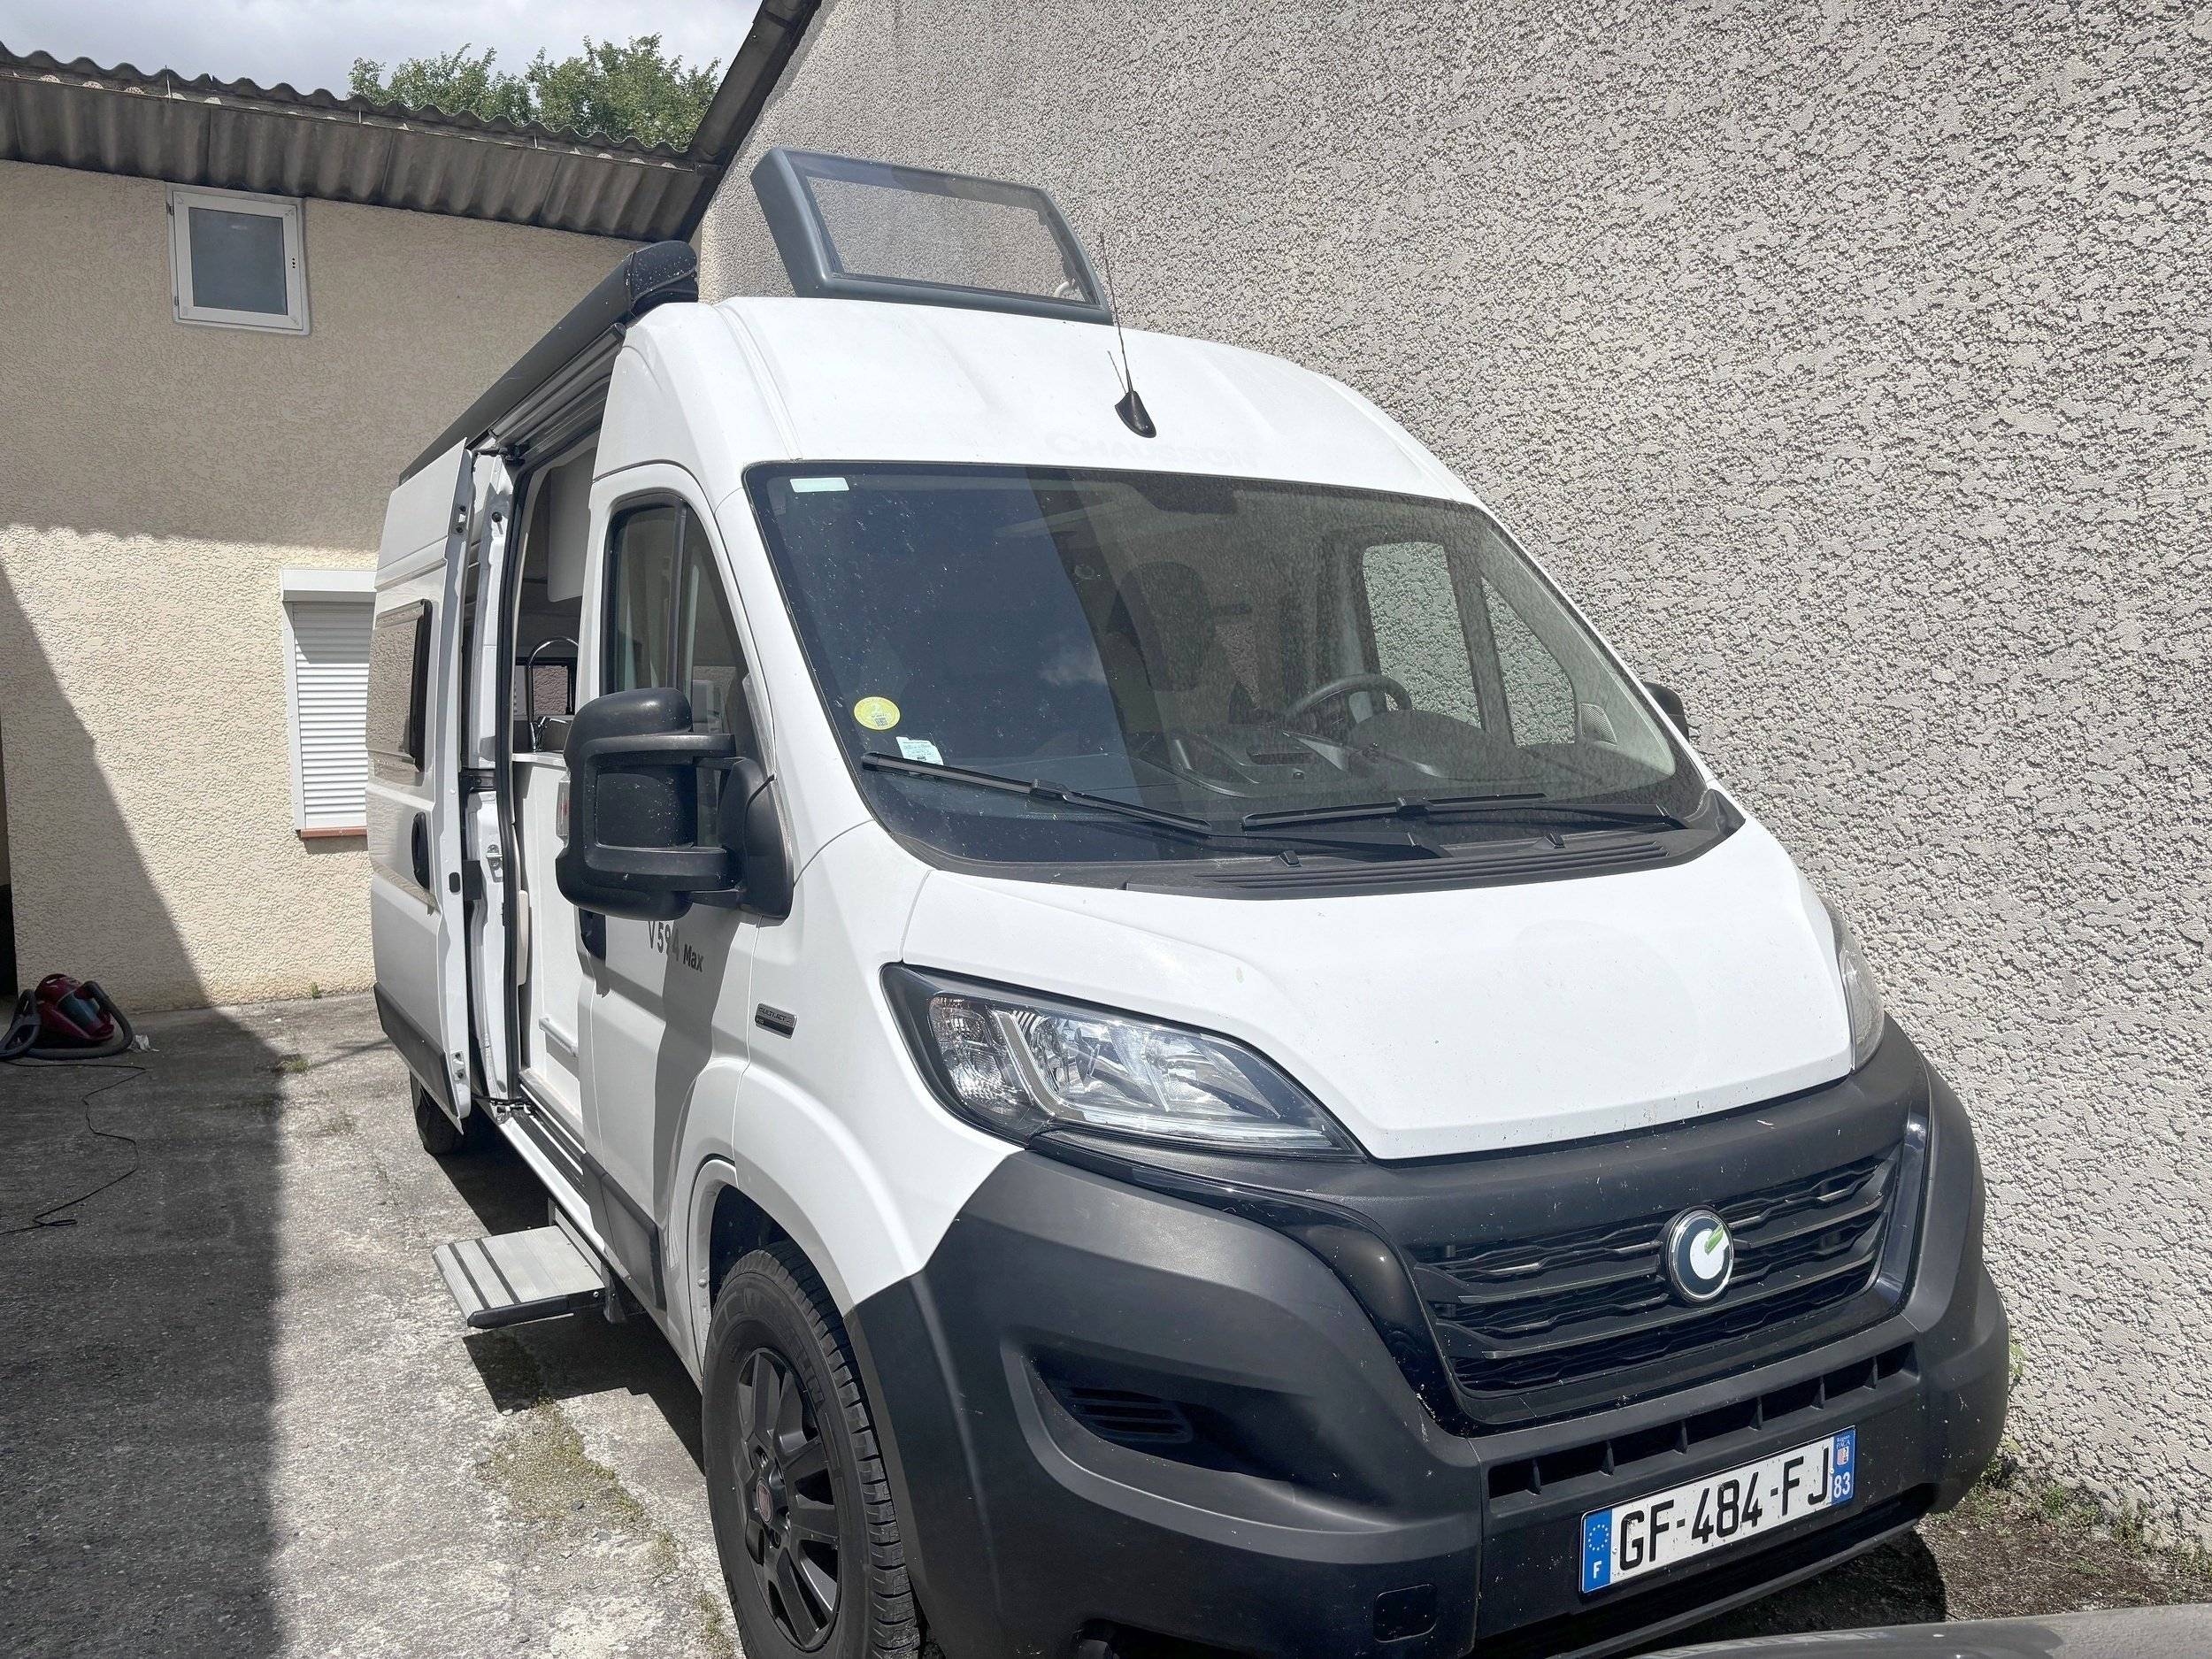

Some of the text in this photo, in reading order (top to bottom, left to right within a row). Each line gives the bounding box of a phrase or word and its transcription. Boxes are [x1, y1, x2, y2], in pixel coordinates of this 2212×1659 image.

[682, 943, 704, 972] Max
[1833, 1471, 1851, 1499] 83
[1619, 1447, 1830, 1571] GF-484-FJ
[1593, 1560, 1602, 1580] F
